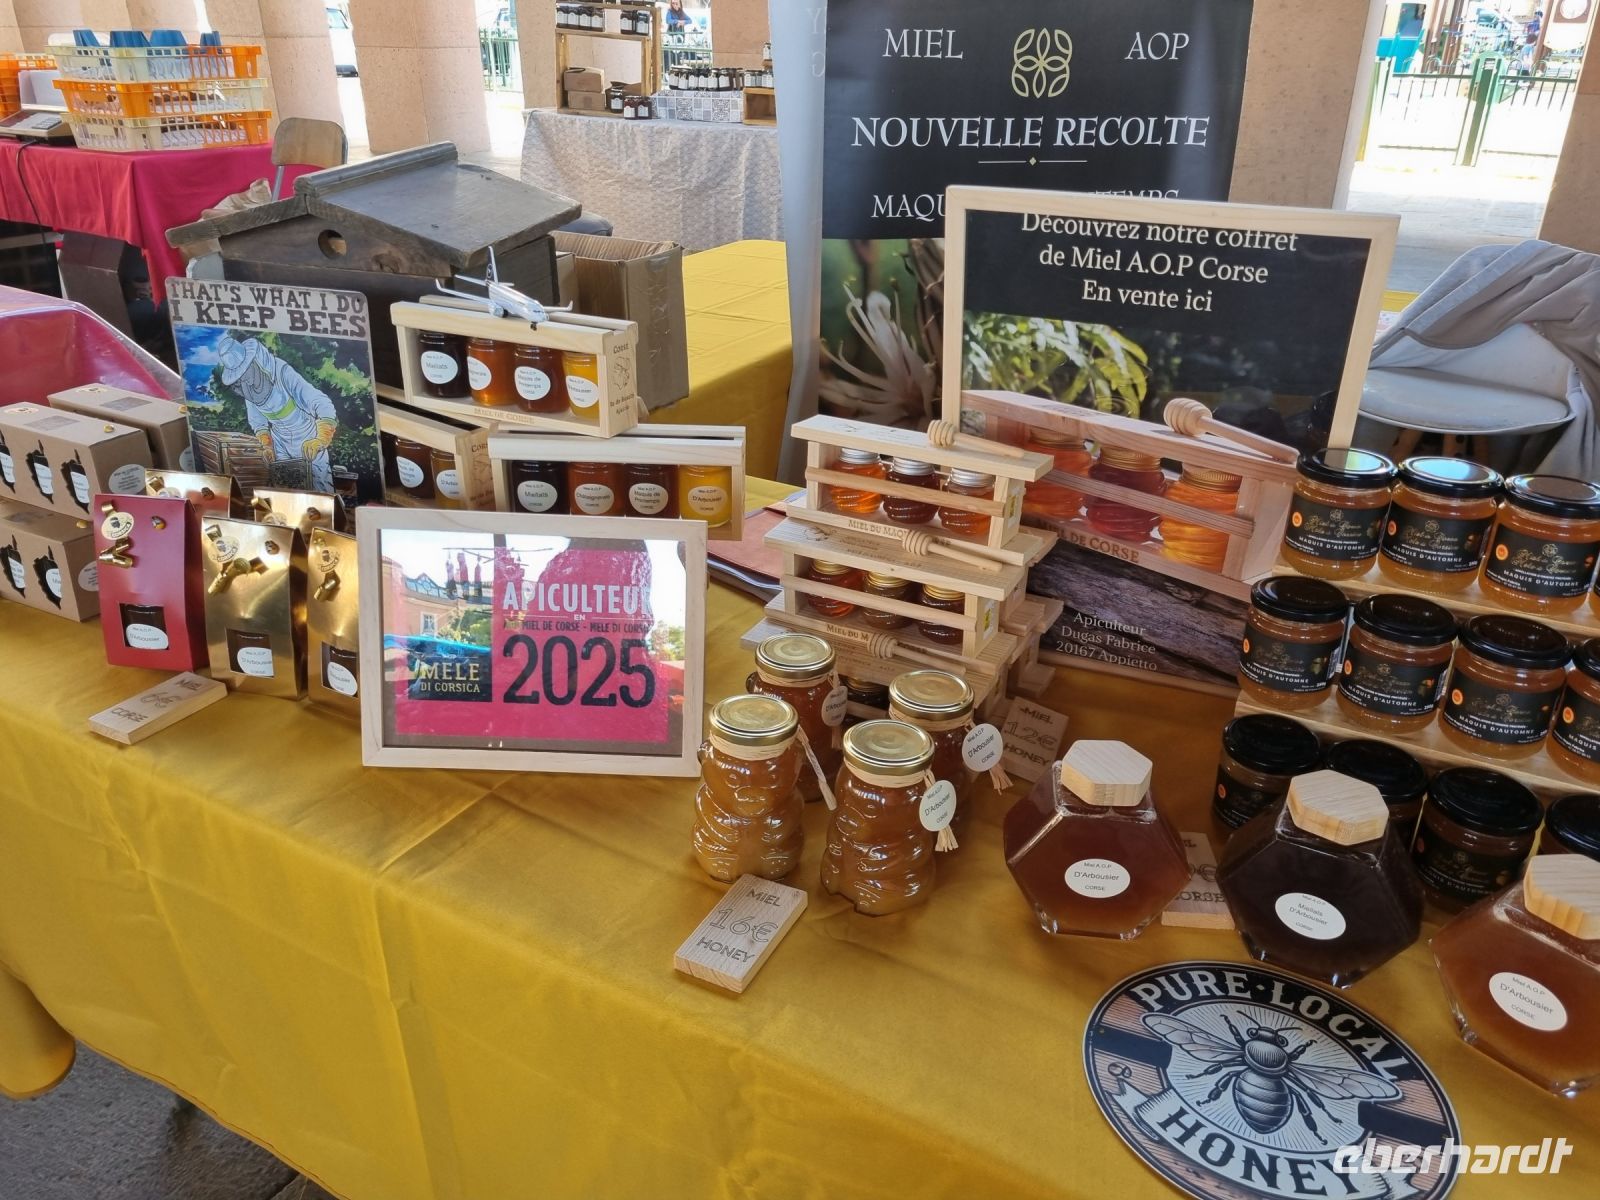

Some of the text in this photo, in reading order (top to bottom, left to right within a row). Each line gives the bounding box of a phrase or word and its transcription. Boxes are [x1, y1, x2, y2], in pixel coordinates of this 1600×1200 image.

[882, 28, 964, 59] MIEL
[1124, 31, 1190, 60] AOP
[851, 115, 1210, 148] NOUVELLE RECOLTE
[871, 194, 946, 222] MAQU
[1021, 213, 1140, 240] Découvrez
[1145, 224, 1209, 245] notre
[1039, 245, 1269, 283] de Miel A.O.P Corse
[171, 281, 365, 313] THAT'S WHAT I DO
[1082, 279, 1213, 312] En vente ici
[172, 300, 366, 338] I KEEP BEES
[1071, 531, 1086, 546] DE
[1089, 538, 1140, 563] CORSE
[1073, 612, 1146, 636] Apiculteur
[1056, 641, 1096, 657] 20167
[1062, 625, 1156, 654] Dugas Fabrice
[420, 663, 480, 681] MELE
[503, 634, 656, 708] 2025
[420, 682, 481, 693] DI CORSICA
[1004, 742, 1049, 766] HONEY
[1074, 871, 1120, 880] D'Arbousier
[746, 889, 781, 907] MIEL
[710, 908, 779, 943] 16€
[1289, 907, 1328, 925] D'Arbousier
[696, 936, 755, 962] HONEY
[1500, 983, 1554, 1014] D'Arbousier
[1511, 1004, 1537, 1019] CORSE
[1130, 970, 1411, 1082] PURE LOCAL
[1156, 1106, 1361, 1196] HONEY
